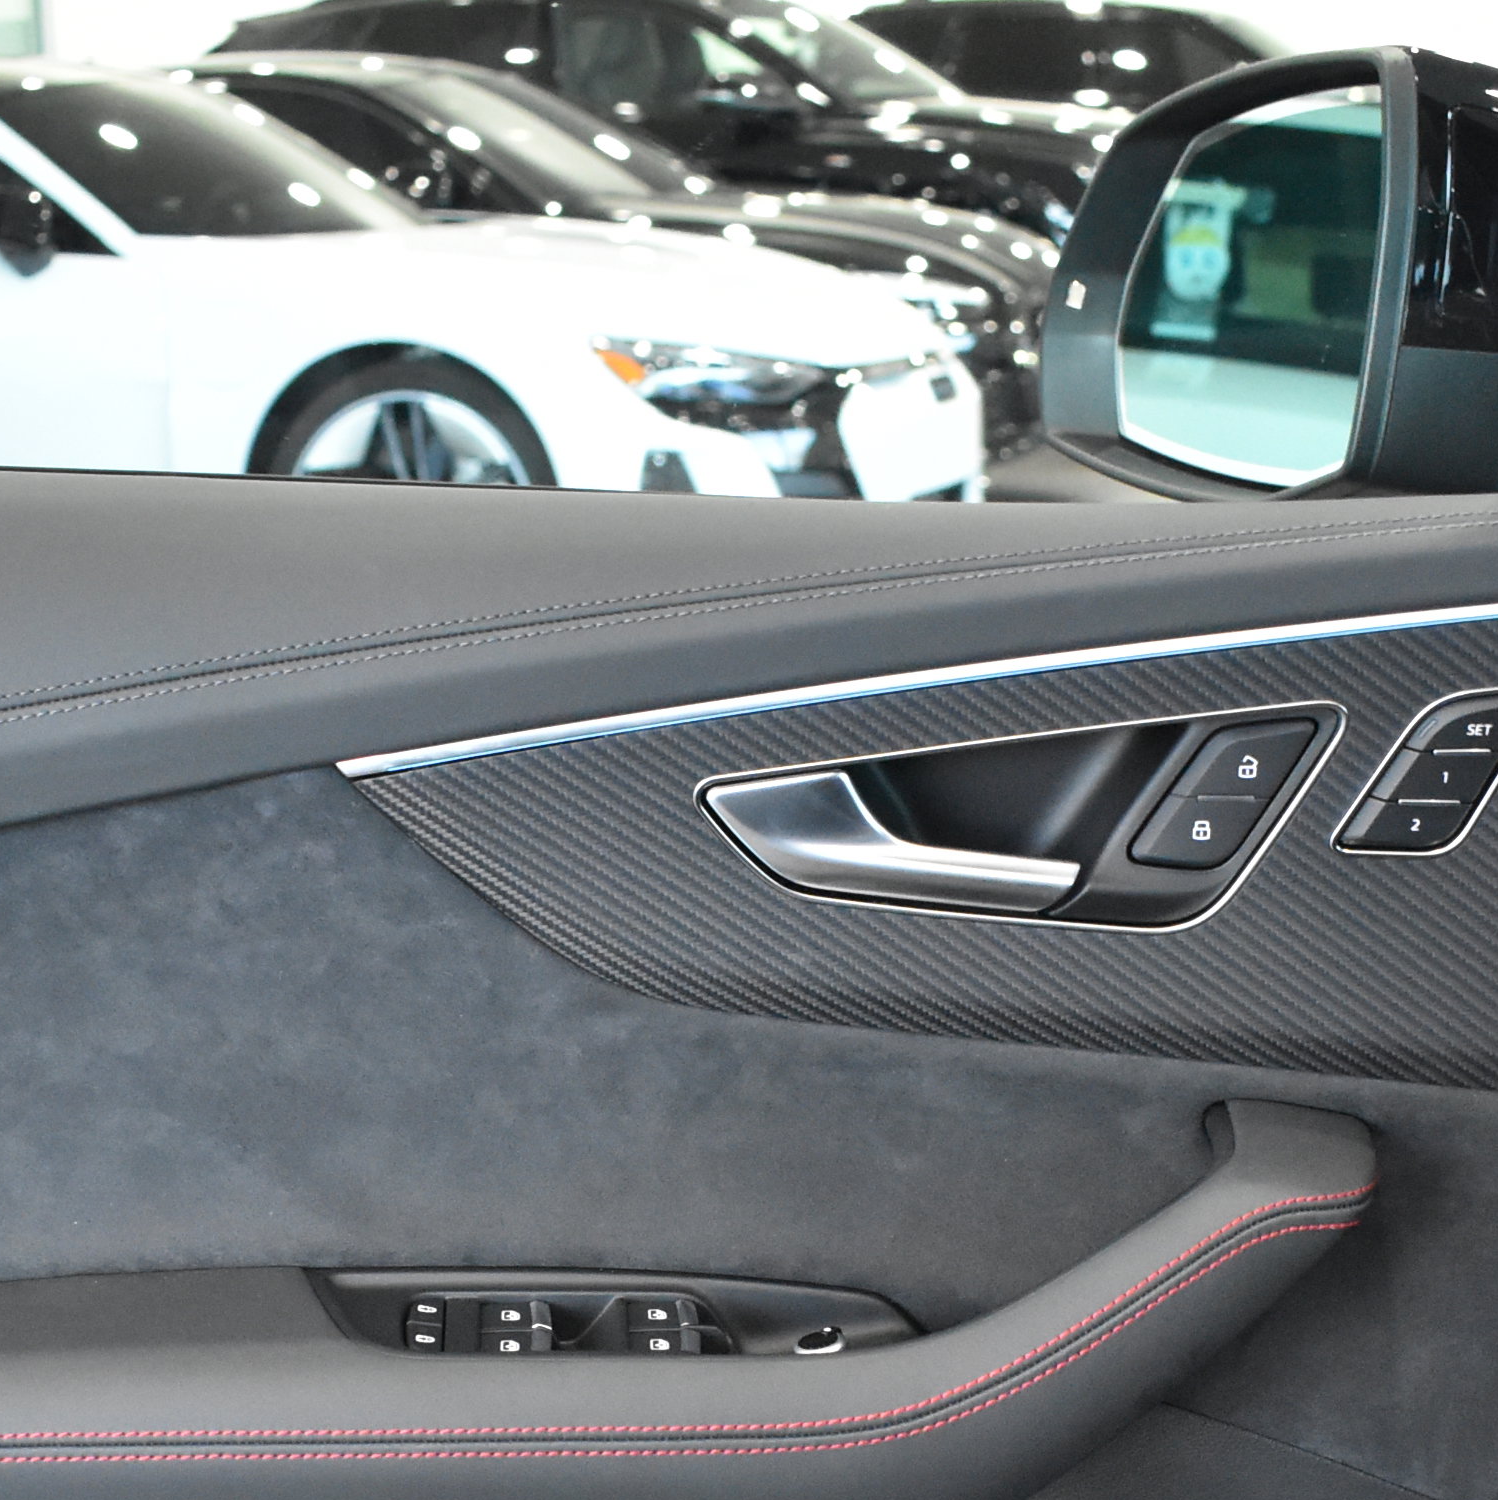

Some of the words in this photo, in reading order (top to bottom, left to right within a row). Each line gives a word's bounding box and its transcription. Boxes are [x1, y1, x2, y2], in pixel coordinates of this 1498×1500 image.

[1466, 723, 1493, 737] SET
[1442, 771, 1450, 784] 1
[1410, 818, 1421, 832] 2
